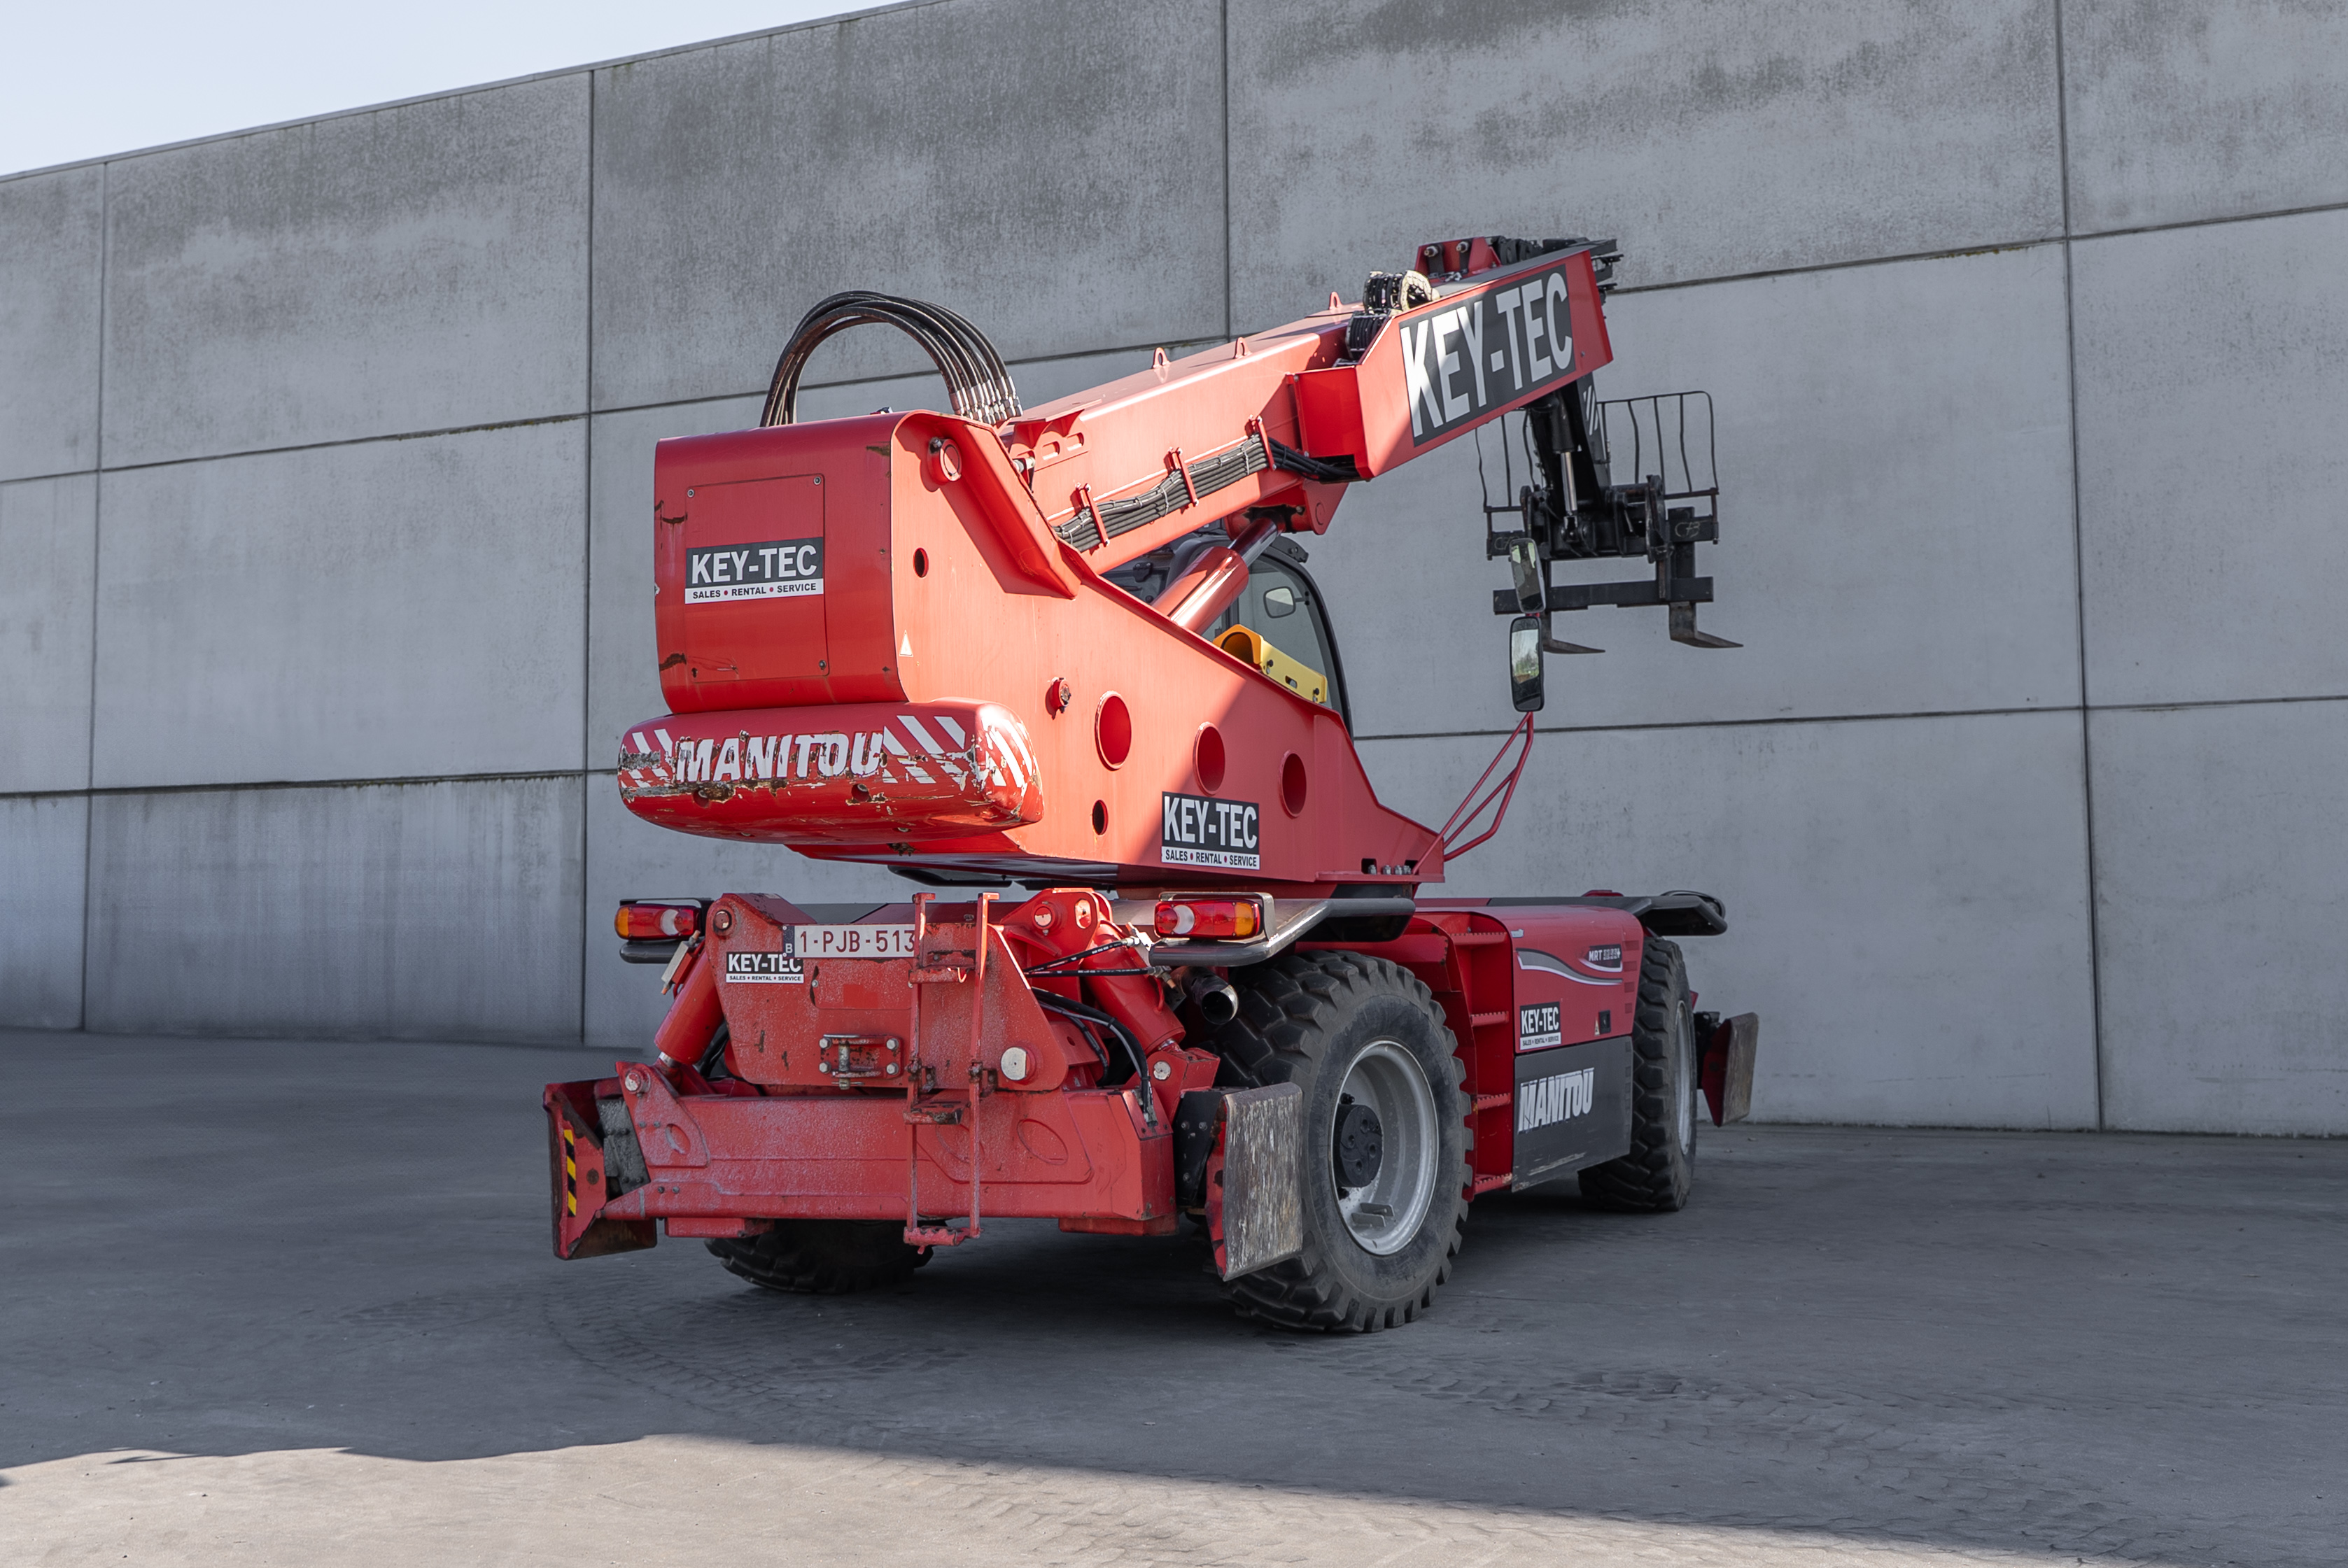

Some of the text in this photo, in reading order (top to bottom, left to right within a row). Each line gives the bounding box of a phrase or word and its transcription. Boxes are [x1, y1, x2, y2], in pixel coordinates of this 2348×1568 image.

[1400, 272, 1573, 437] KEY-TEC
[691, 544, 817, 584] KEY-TEC
[692, 582, 817, 600] SALES RENTAL SERVICE
[675, 732, 885, 782] MANITOU
[1164, 796, 1258, 849] KEY-TEC
[1165, 849, 1257, 867] SALES RENTAL SERVICE
[728, 954, 802, 973] KEY-TEC
[785, 943, 793, 954] B
[1521, 1006, 1559, 1035] KEY-TEC
[1517, 1067, 1595, 1134] MANITOU
